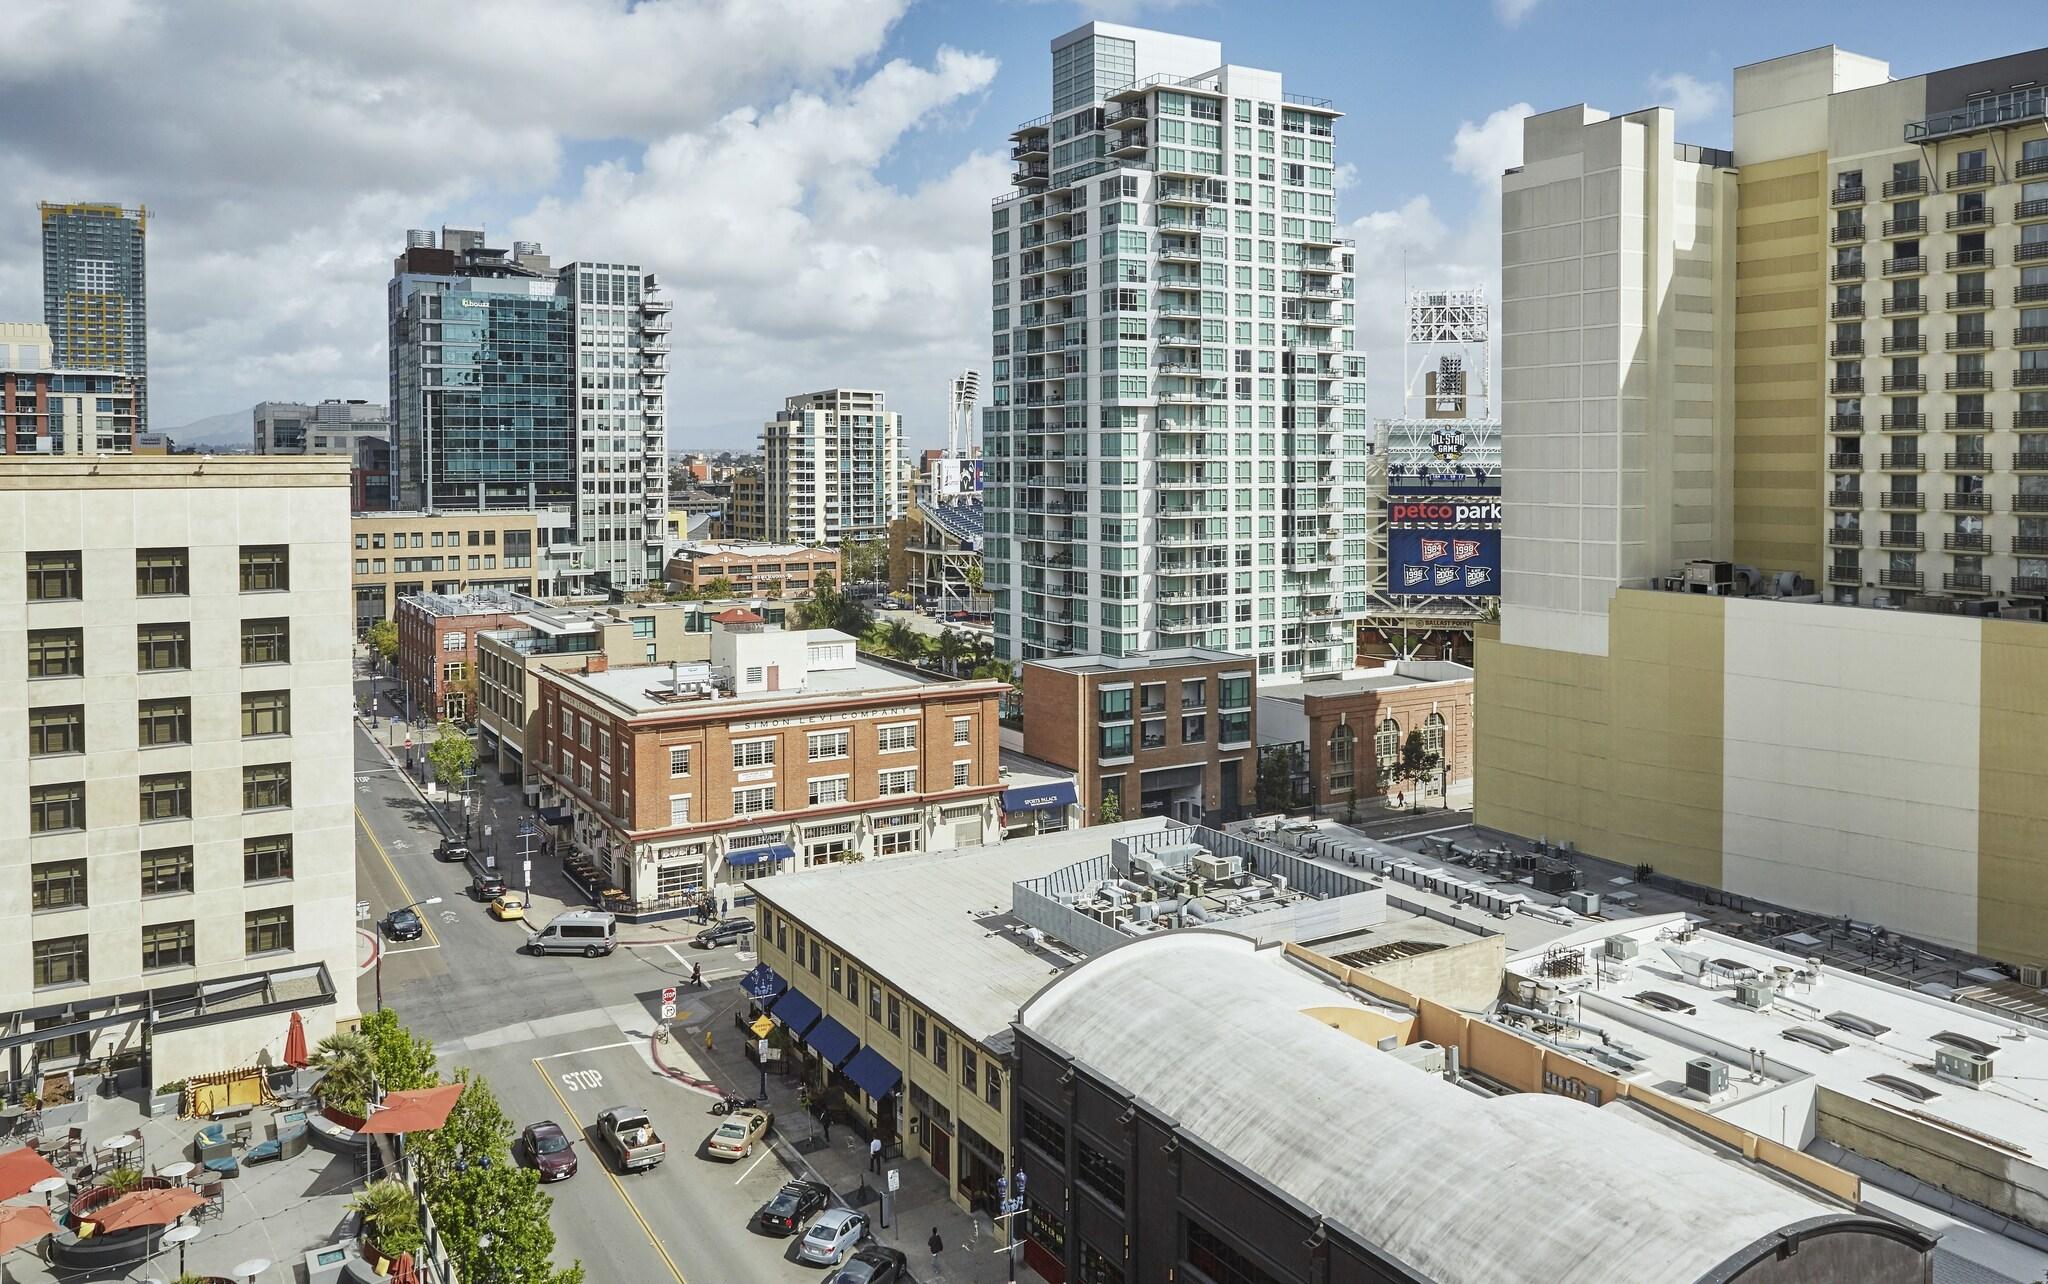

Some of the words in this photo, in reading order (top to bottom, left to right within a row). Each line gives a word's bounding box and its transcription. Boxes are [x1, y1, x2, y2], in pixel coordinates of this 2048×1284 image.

[1438, 445, 1458, 453] GAME
[1393, 504, 1453, 521] petco
[1456, 504, 1502, 522] park
[1424, 545, 1442, 555] 1984
[1456, 545, 1474, 555] 1998
[1436, 569, 1454, 579] 2005
[744, 718, 791, 730] SIMON
[799, 714, 833, 724] LEVI
[841, 706, 909, 720] COMPANY
[663, 992, 676, 1000] STOP
[562, 1069, 603, 1092] STOP
